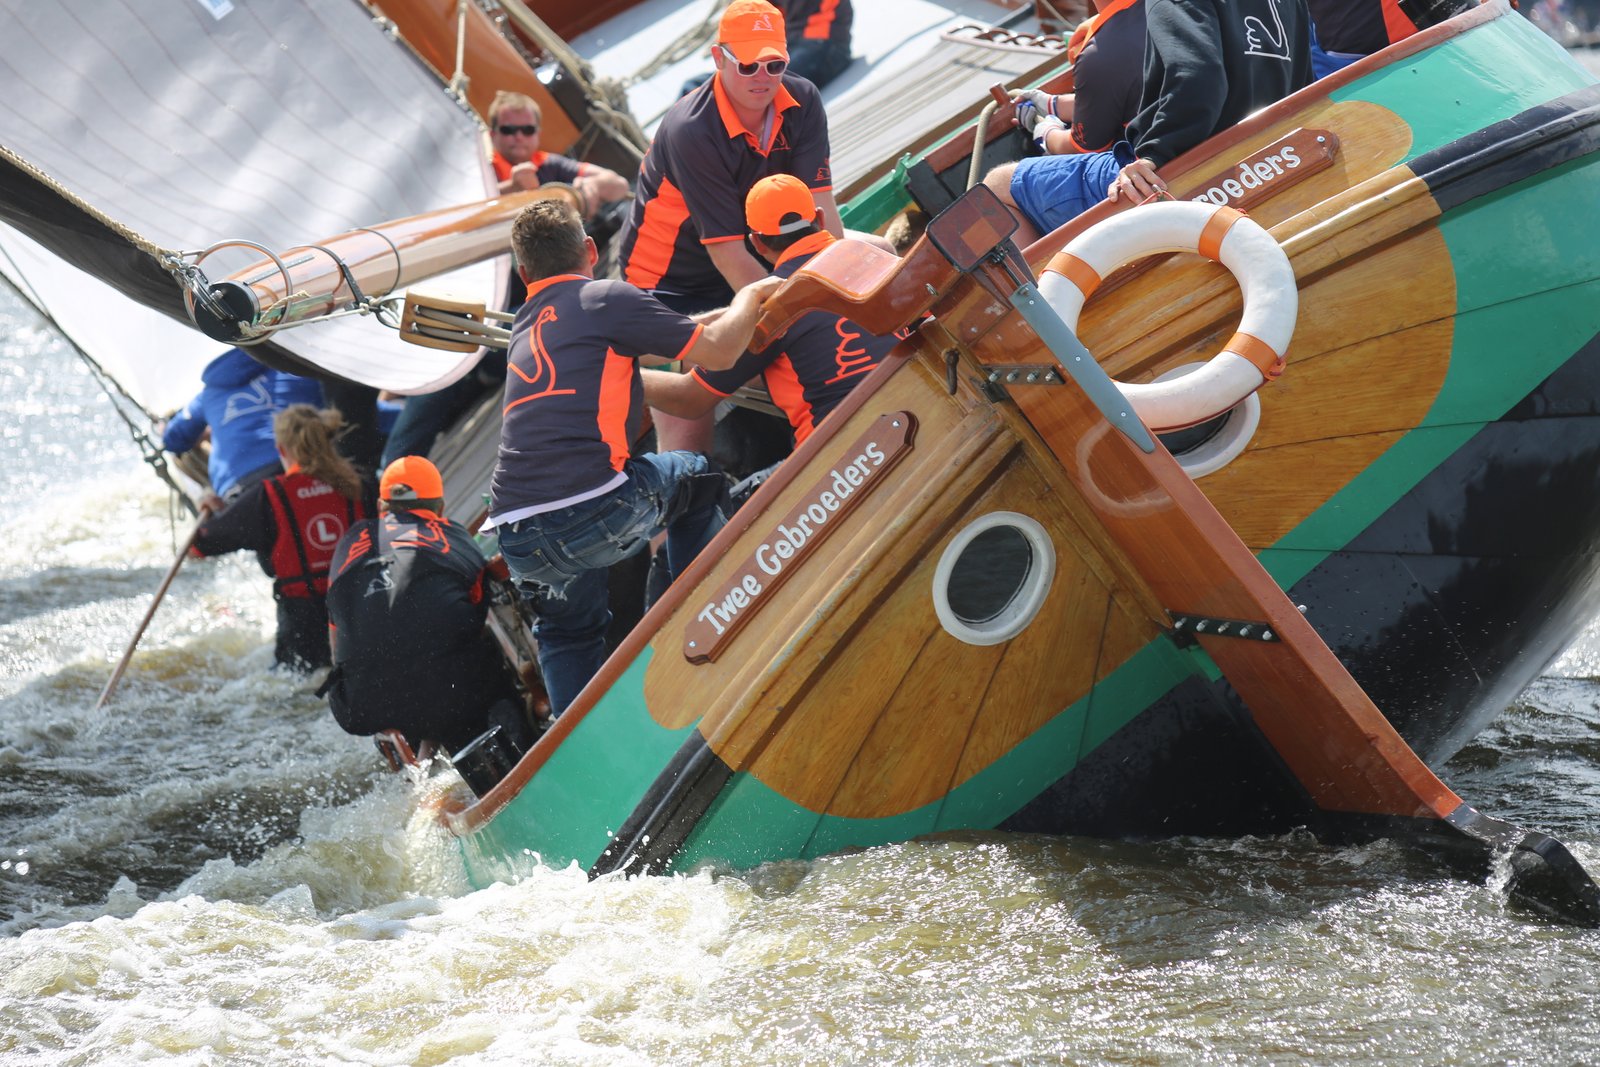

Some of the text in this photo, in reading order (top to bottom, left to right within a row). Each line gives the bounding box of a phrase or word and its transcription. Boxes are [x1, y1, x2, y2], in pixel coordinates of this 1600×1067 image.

[316, 520, 337, 543] L
[698, 441, 885, 635] Twee Gebroeders
